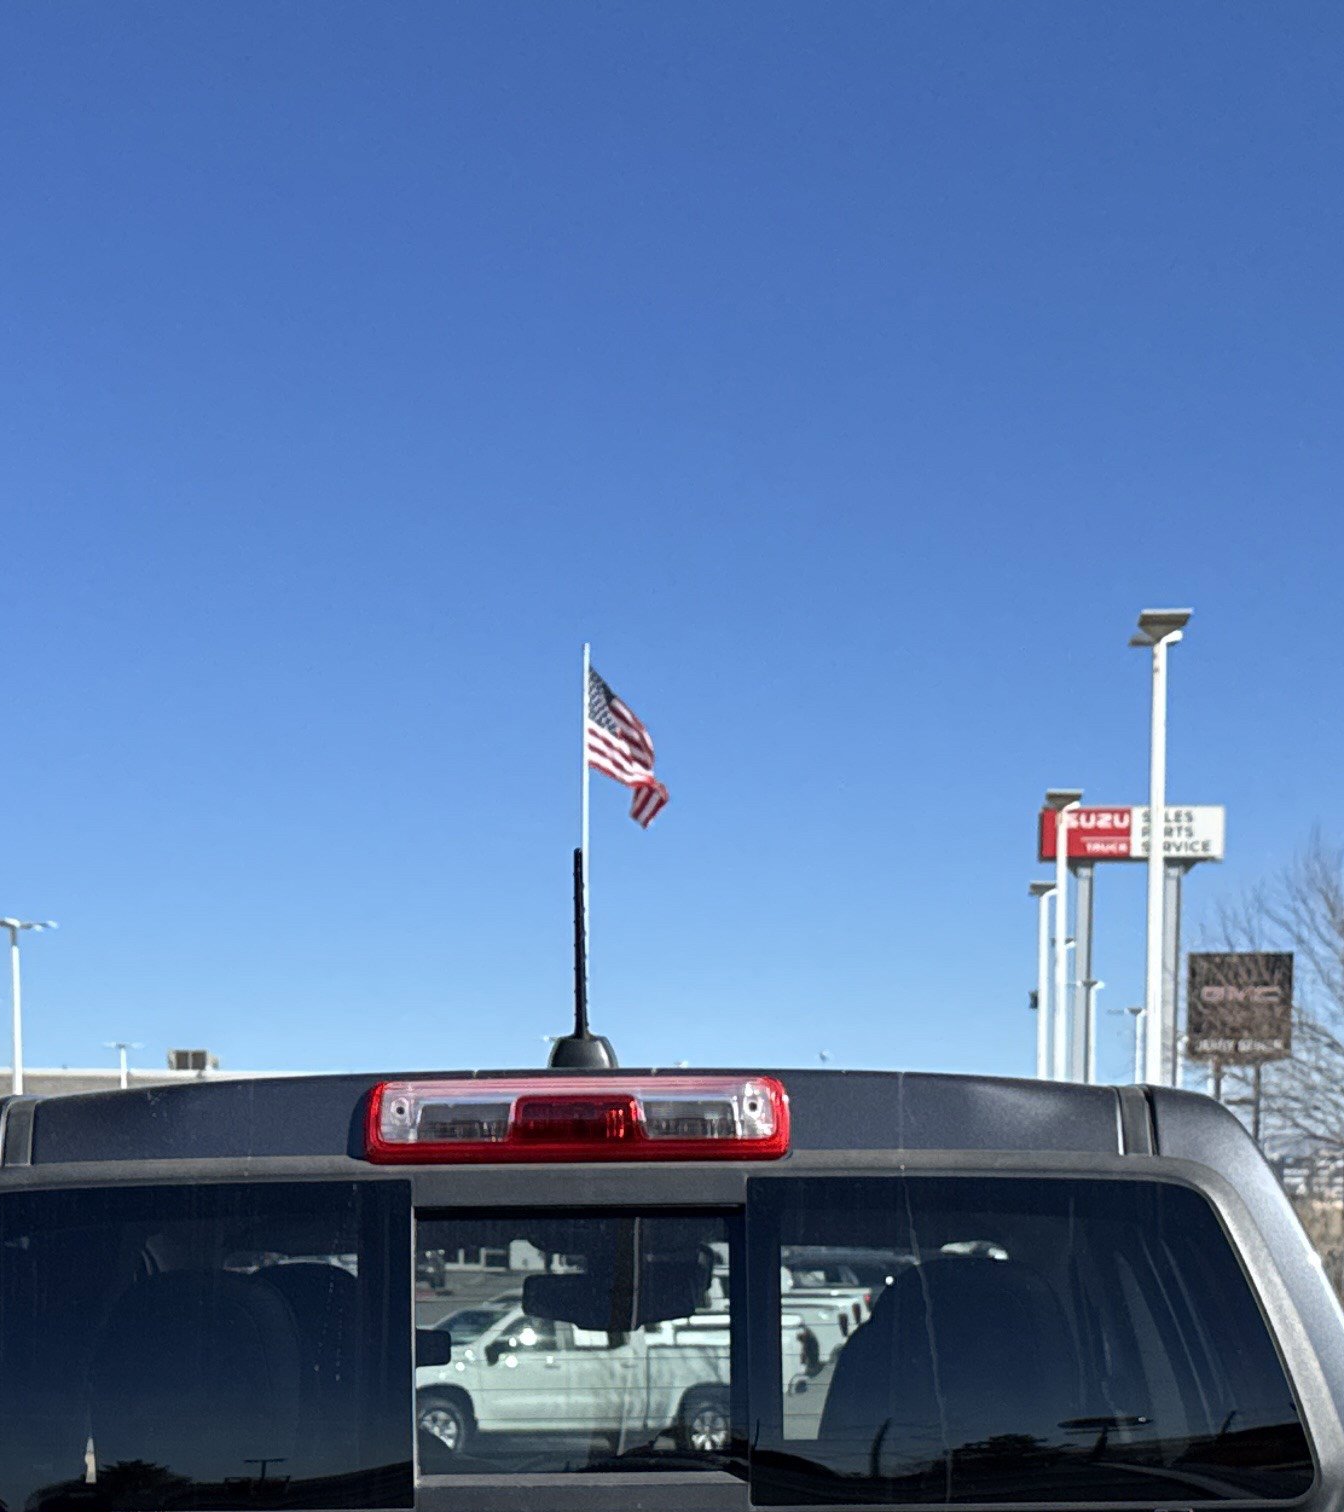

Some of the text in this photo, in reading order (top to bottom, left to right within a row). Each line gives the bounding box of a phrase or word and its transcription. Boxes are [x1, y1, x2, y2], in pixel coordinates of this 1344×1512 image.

[1058, 812, 1130, 829] SUZU
[1141, 811, 1194, 823] SLES
[1141, 826, 1194, 838] PRTS
[1141, 840, 1212, 853] SRVICE
